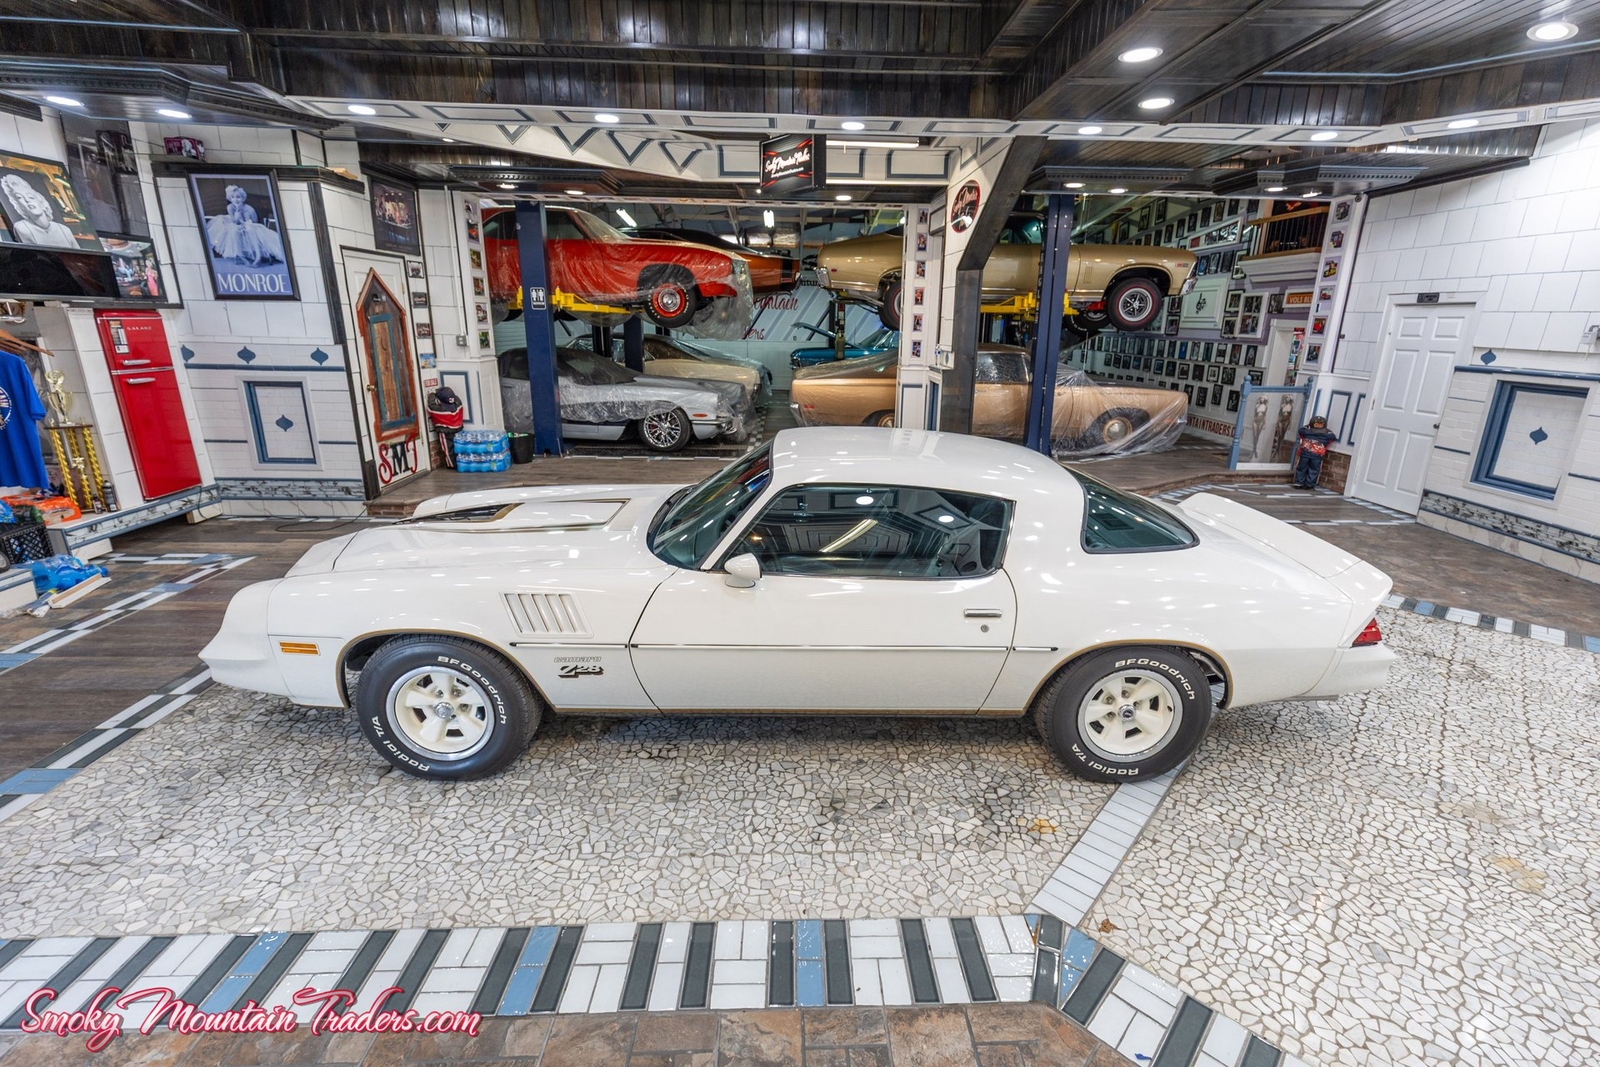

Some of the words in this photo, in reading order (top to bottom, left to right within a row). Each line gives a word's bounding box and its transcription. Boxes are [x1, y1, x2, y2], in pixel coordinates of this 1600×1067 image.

[217, 273, 291, 293] MONROE
[557, 664, 605, 679] Z28
[1114, 658, 1196, 701] BFGoodrich
[437, 655, 507, 725] BFGoodrich
[371, 715, 385, 738] T/A
[1071, 743, 1087, 762] T/A
